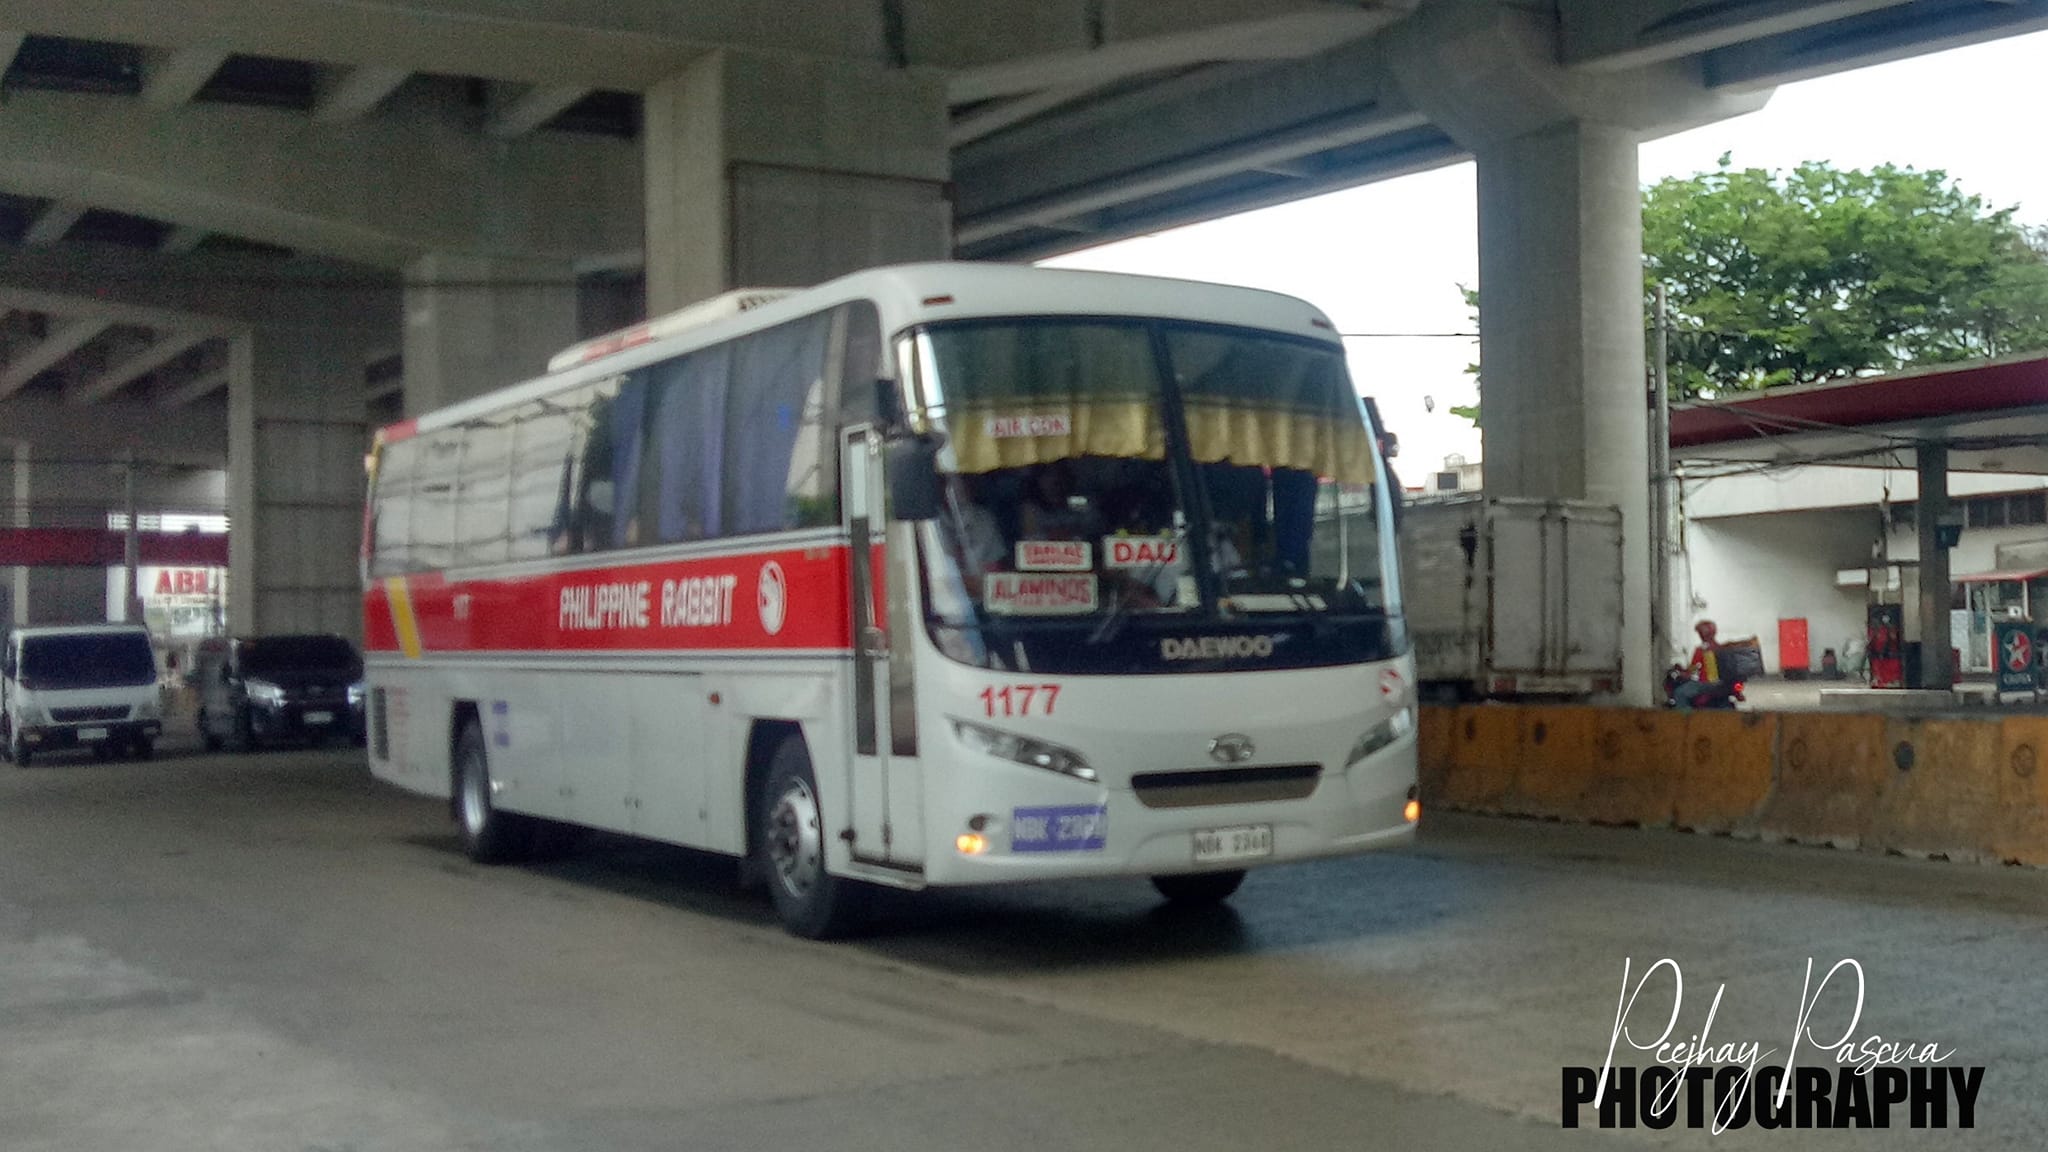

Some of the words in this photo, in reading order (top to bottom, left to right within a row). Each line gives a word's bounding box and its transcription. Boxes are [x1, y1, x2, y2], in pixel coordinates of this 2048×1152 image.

[1113, 542, 1177, 563] DAU
[559, 582, 650, 629] PHILIPPINE
[661, 575, 737, 626] RABBIT
[1161, 634, 1273, 660] DAEWOO
[979, 684, 1062, 718] 1177
